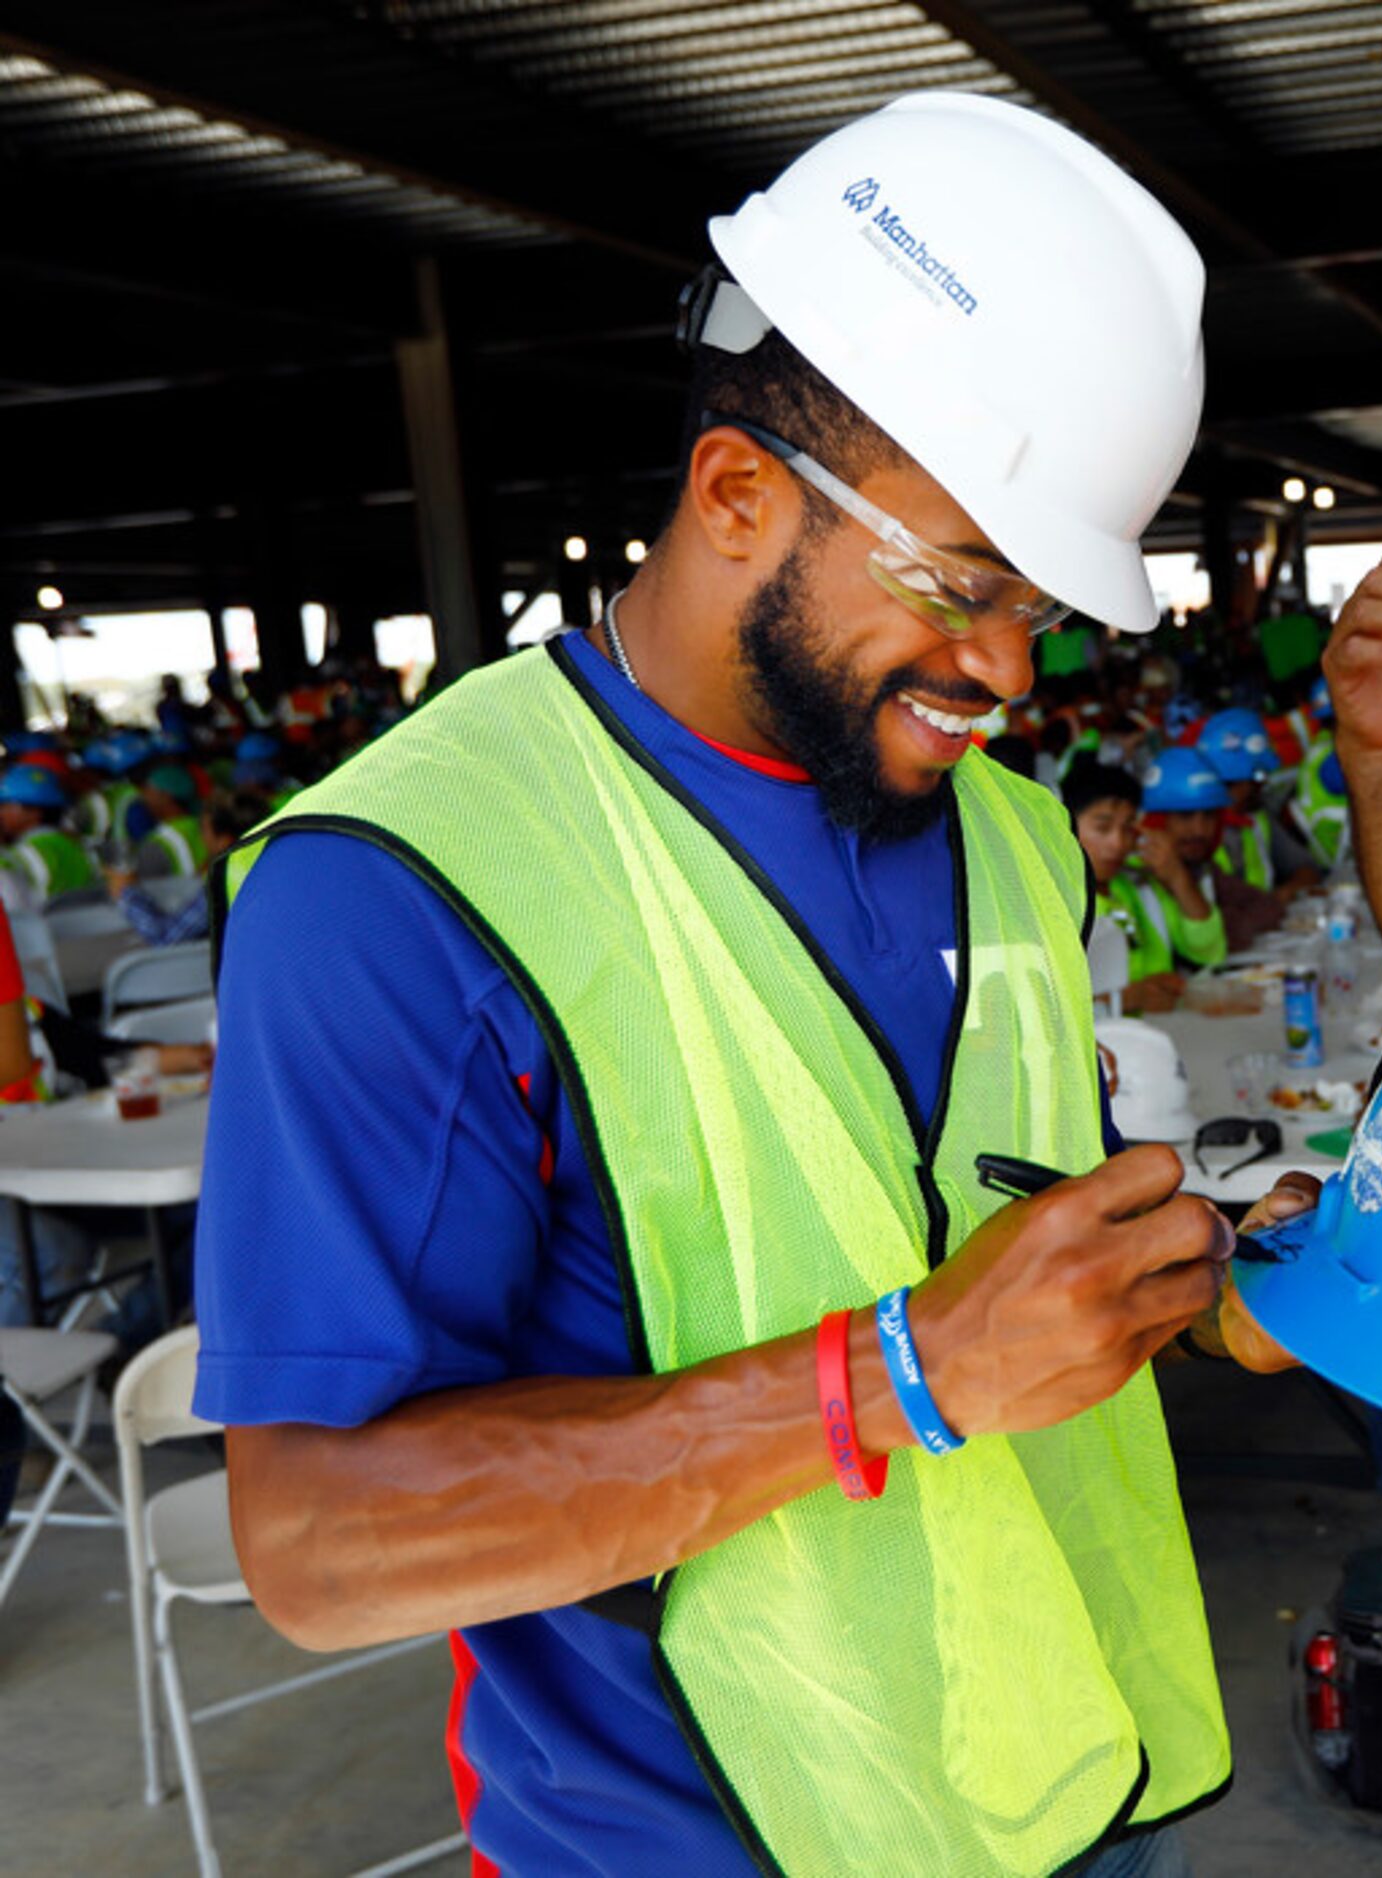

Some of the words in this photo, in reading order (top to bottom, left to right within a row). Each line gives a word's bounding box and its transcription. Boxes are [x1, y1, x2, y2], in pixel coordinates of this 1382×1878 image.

[872, 204, 978, 316] Manhattan
[895, 1332, 921, 1384] ACTIVE
[827, 1398, 868, 1500] COMPE
[924, 1429, 952, 1456] LAY
